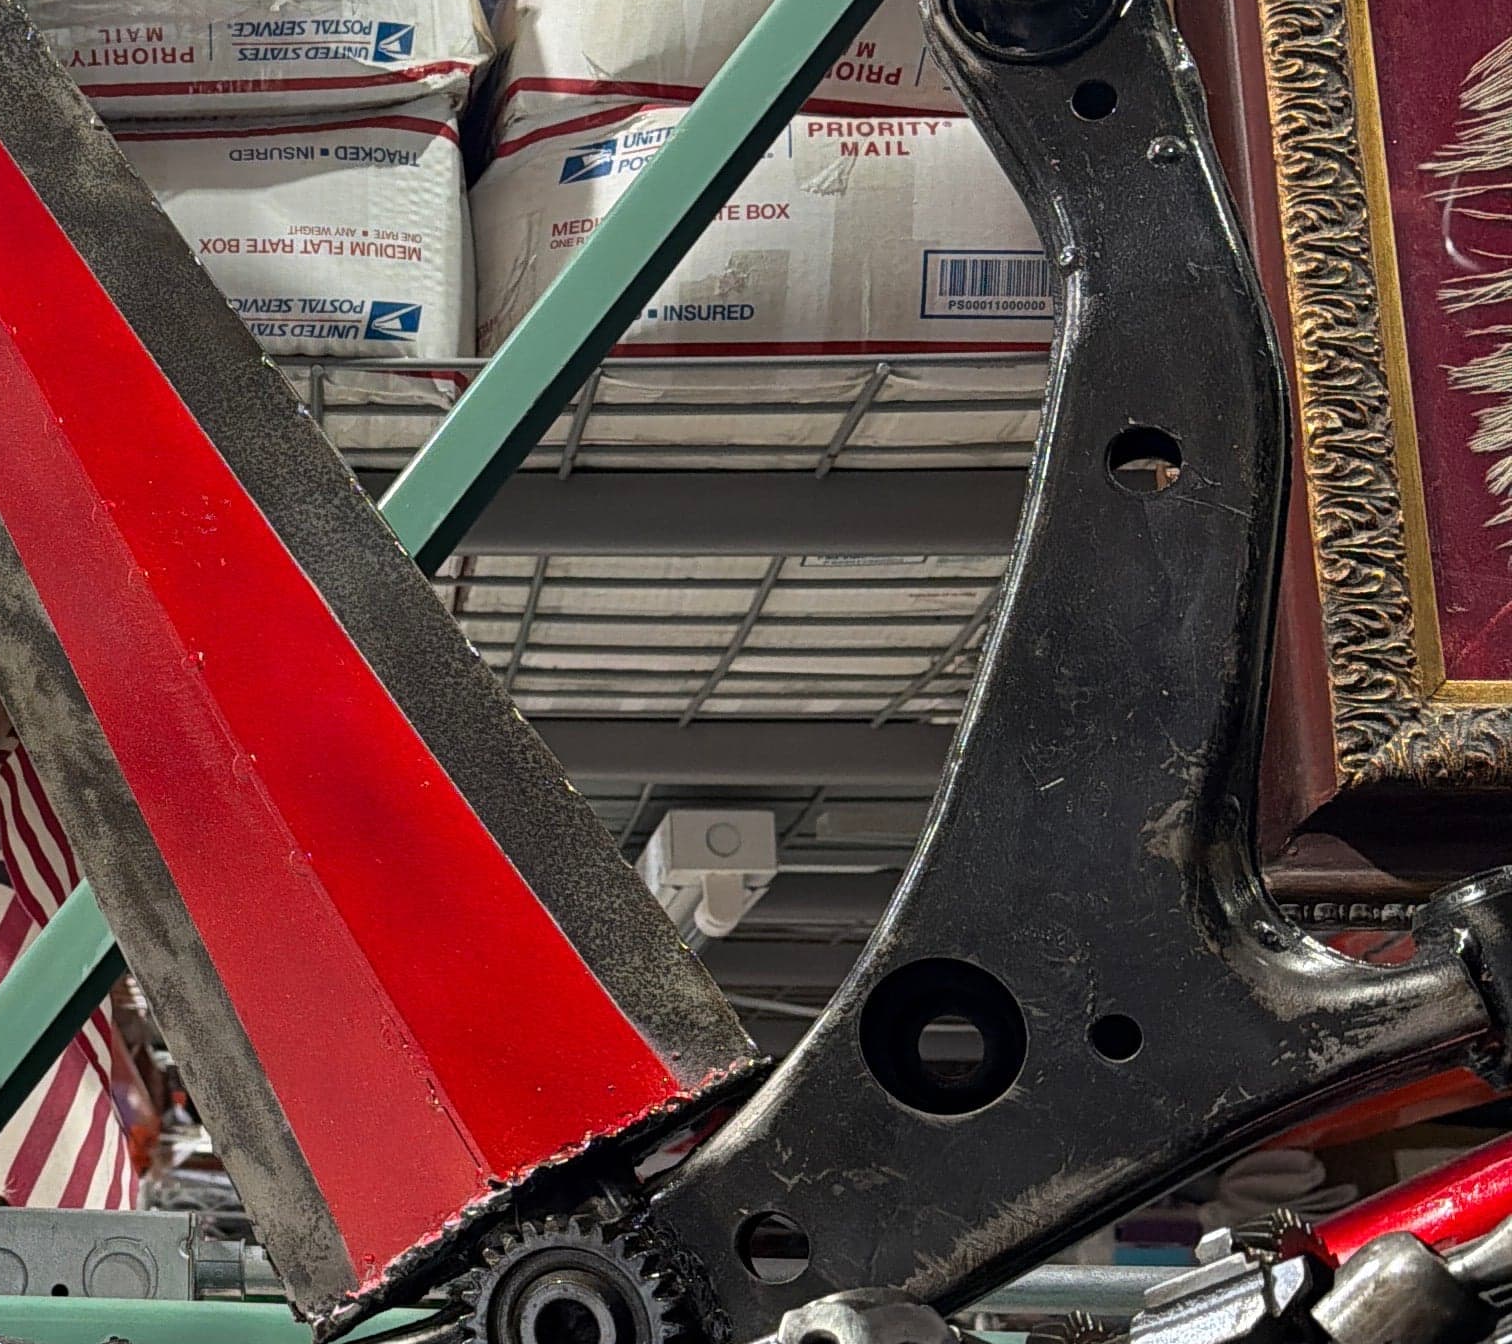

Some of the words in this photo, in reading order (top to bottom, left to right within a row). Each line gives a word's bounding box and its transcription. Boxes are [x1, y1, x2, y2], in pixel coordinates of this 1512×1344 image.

[99, 25, 164, 43] MAIL
[311, 20, 372, 37] POSTAL
[238, 45, 300, 62] STATES
[309, 45, 370, 61] UNITED
[229, 146, 315, 162] INSURED
[334, 145, 420, 168] TRACKED
[840, 141, 910, 156] MAIL
[746, 203, 791, 220] BOX
[287, 225, 333, 236] WEIGHT
[334, 227, 357, 238] ANY
[373, 229, 399, 240] RATE
[403, 233, 423, 244] ONE
[199, 238, 239, 254] BOX
[246, 238, 294, 254] RATE
[299, 240, 344, 255] FLAT
[350, 241, 422, 261] MEDIUM
[550, 238, 575, 250] ONE
[229, 298, 292, 313] SERVIC
[300, 299, 365, 314] POSTAL
[663, 304, 755, 321] INSURED
[291, 323, 359, 340] UNITED
